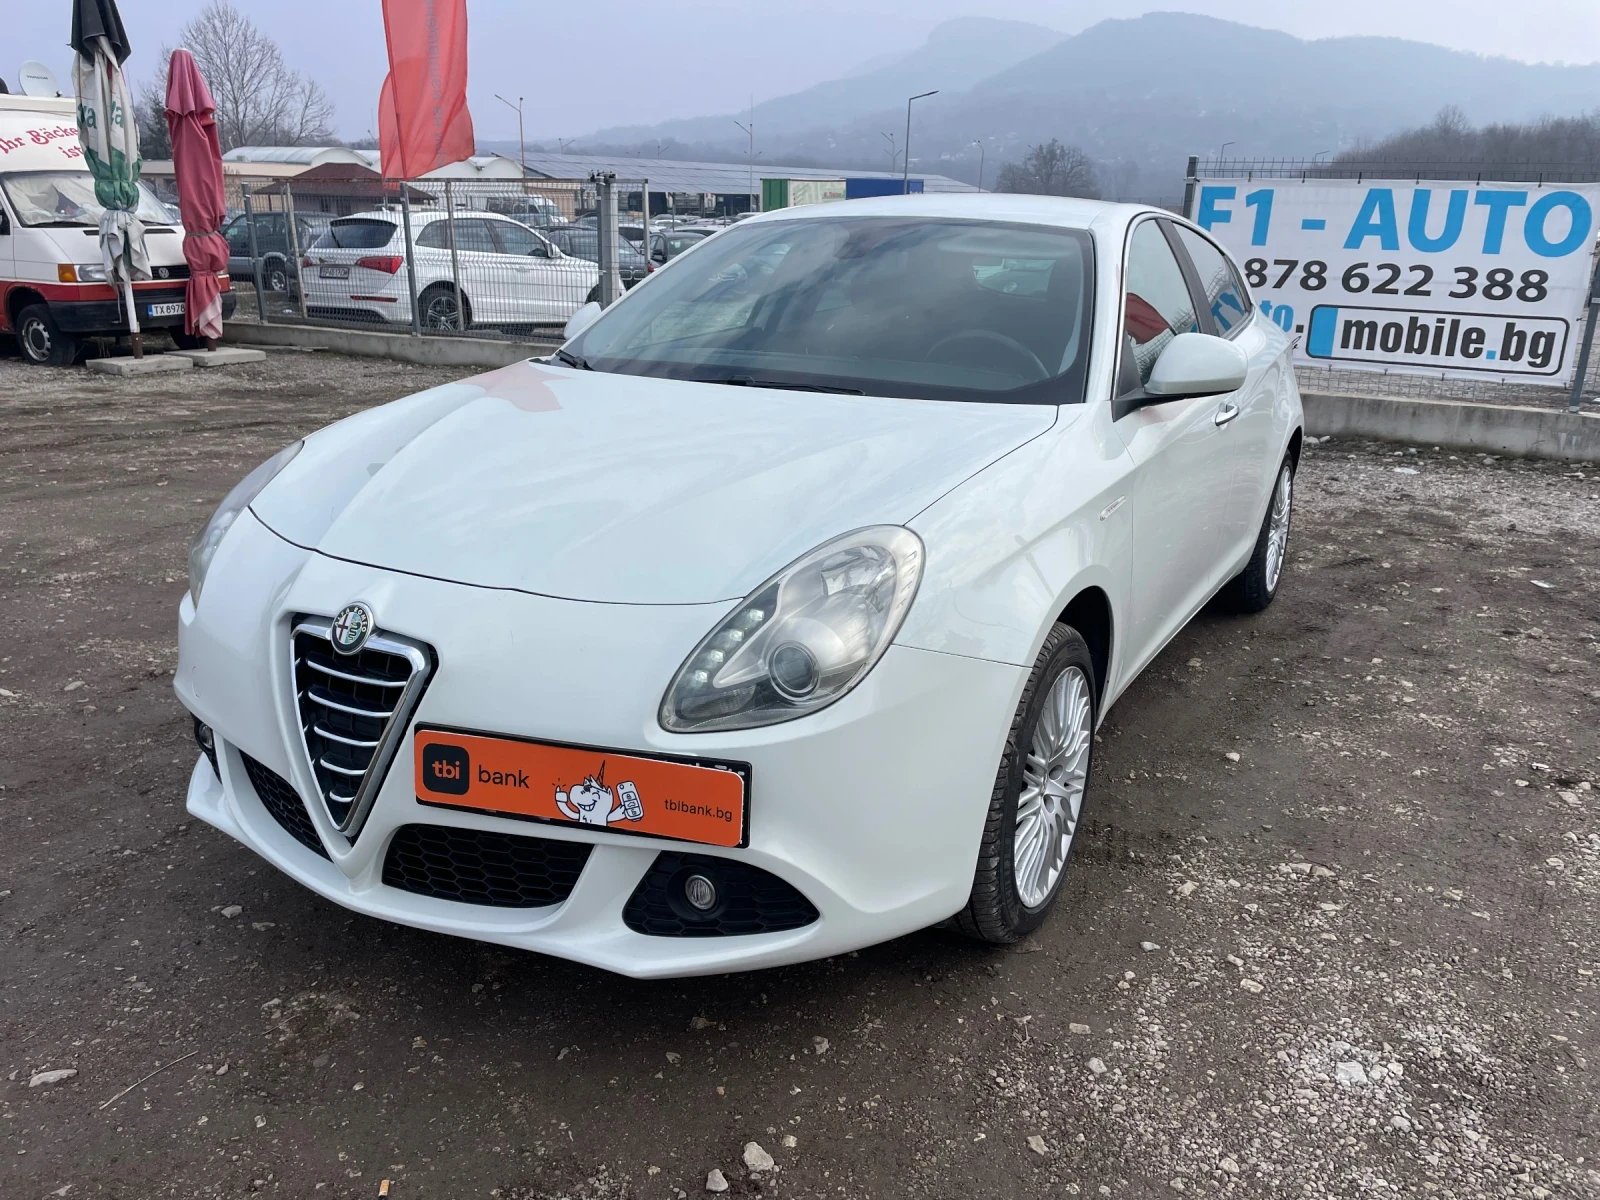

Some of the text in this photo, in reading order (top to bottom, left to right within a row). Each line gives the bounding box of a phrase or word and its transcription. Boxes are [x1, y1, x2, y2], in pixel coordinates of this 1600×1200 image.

[26, 126, 79, 145] Bäcke
[1197, 186, 1275, 246] F1
[1343, 188, 1593, 258] AUTO
[1341, 262, 1434, 296] 622
[1448, 266, 1549, 302] 388
[1341, 316, 1556, 368] mobile.bg
[354, 607, 367, 632] ROMEO
[432, 760, 530, 789] tbi bank
